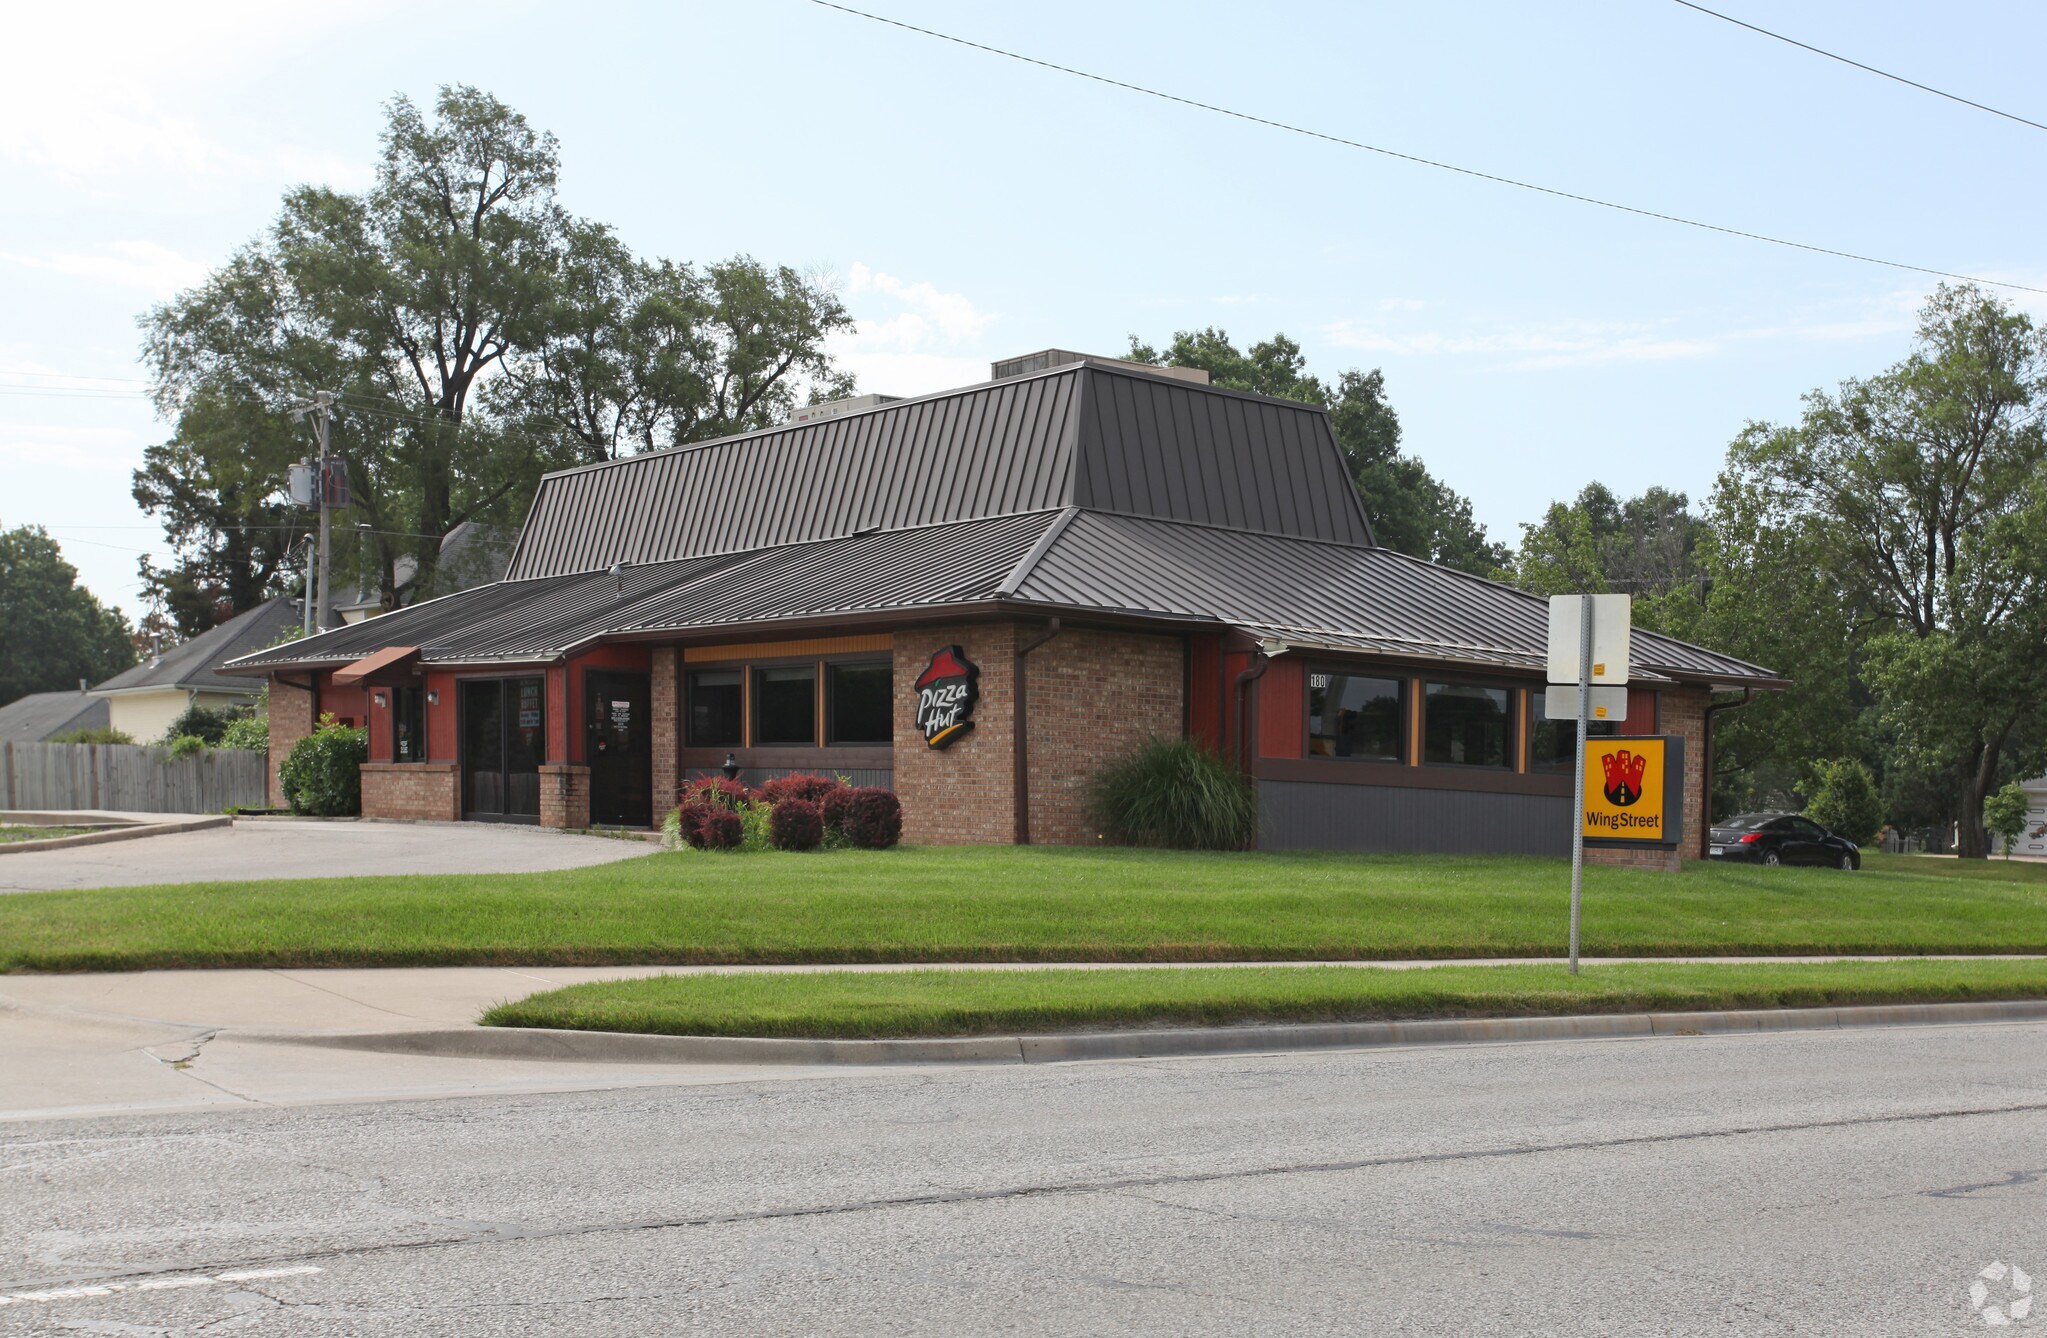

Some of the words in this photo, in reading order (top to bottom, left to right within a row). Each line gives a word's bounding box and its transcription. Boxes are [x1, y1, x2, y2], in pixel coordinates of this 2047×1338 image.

[1311, 675, 1325, 687] 180
[917, 684, 968, 725] Pizza
[925, 703, 962, 737] Hut
[1586, 811, 1660, 830] WingStreet
